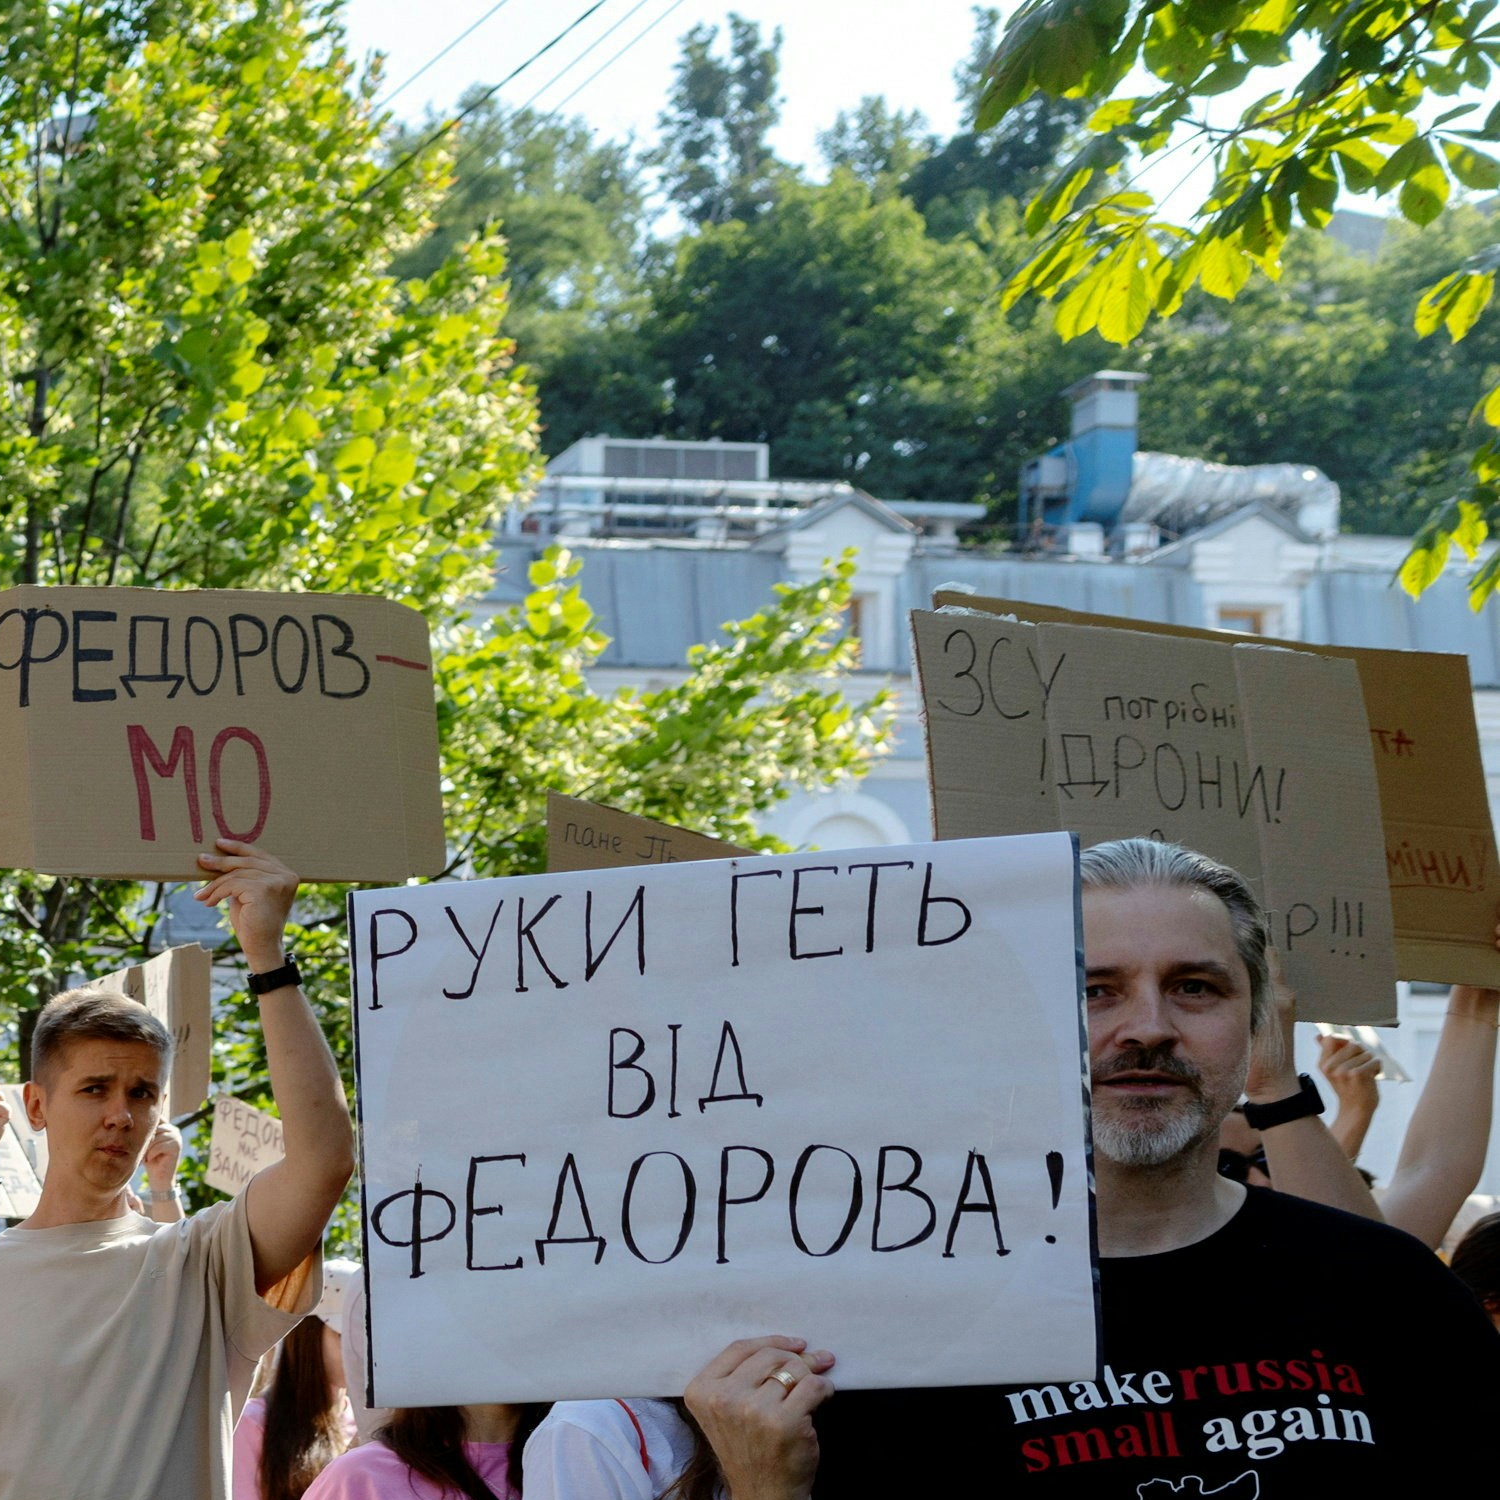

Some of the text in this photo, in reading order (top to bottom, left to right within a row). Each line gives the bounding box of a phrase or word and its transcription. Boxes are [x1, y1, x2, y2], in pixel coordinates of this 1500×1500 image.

[937, 629, 1238, 730] ЗСУ потрібні
[126, 724, 272, 844] МО
[564, 822, 623, 854] пане
[367, 860, 974, 1011] РУКИ ГЕТЬ
[607, 1020, 765, 1119] ВІД
[1004, 1349, 1366, 1425] make russia
[1020, 1393, 1376, 1473] small again
